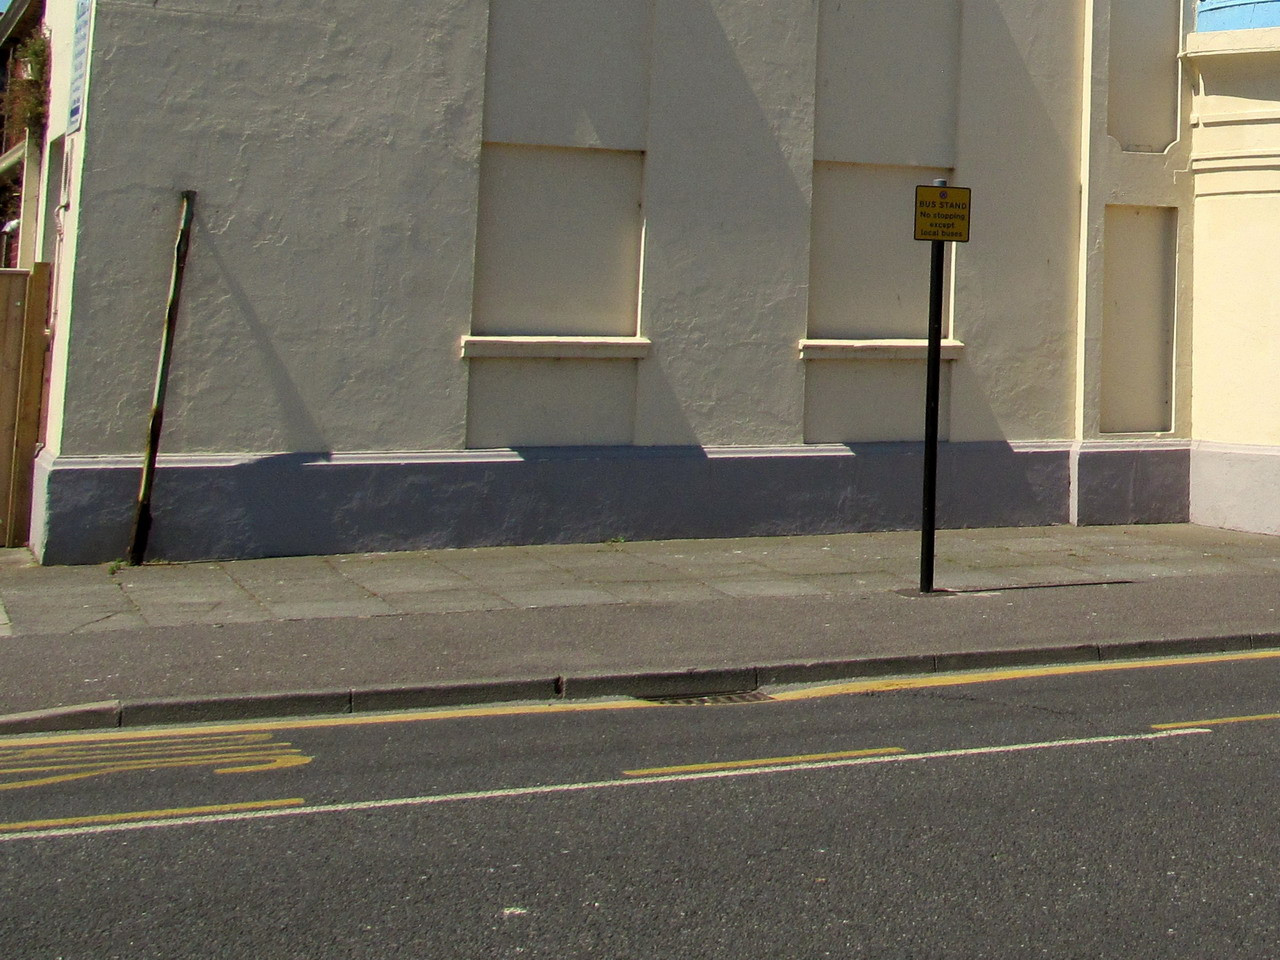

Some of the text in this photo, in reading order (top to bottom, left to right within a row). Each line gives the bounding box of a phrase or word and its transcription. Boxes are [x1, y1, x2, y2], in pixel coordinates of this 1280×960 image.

[919, 200, 967, 210] BUS STAND
[933, 212, 965, 220] stopping
